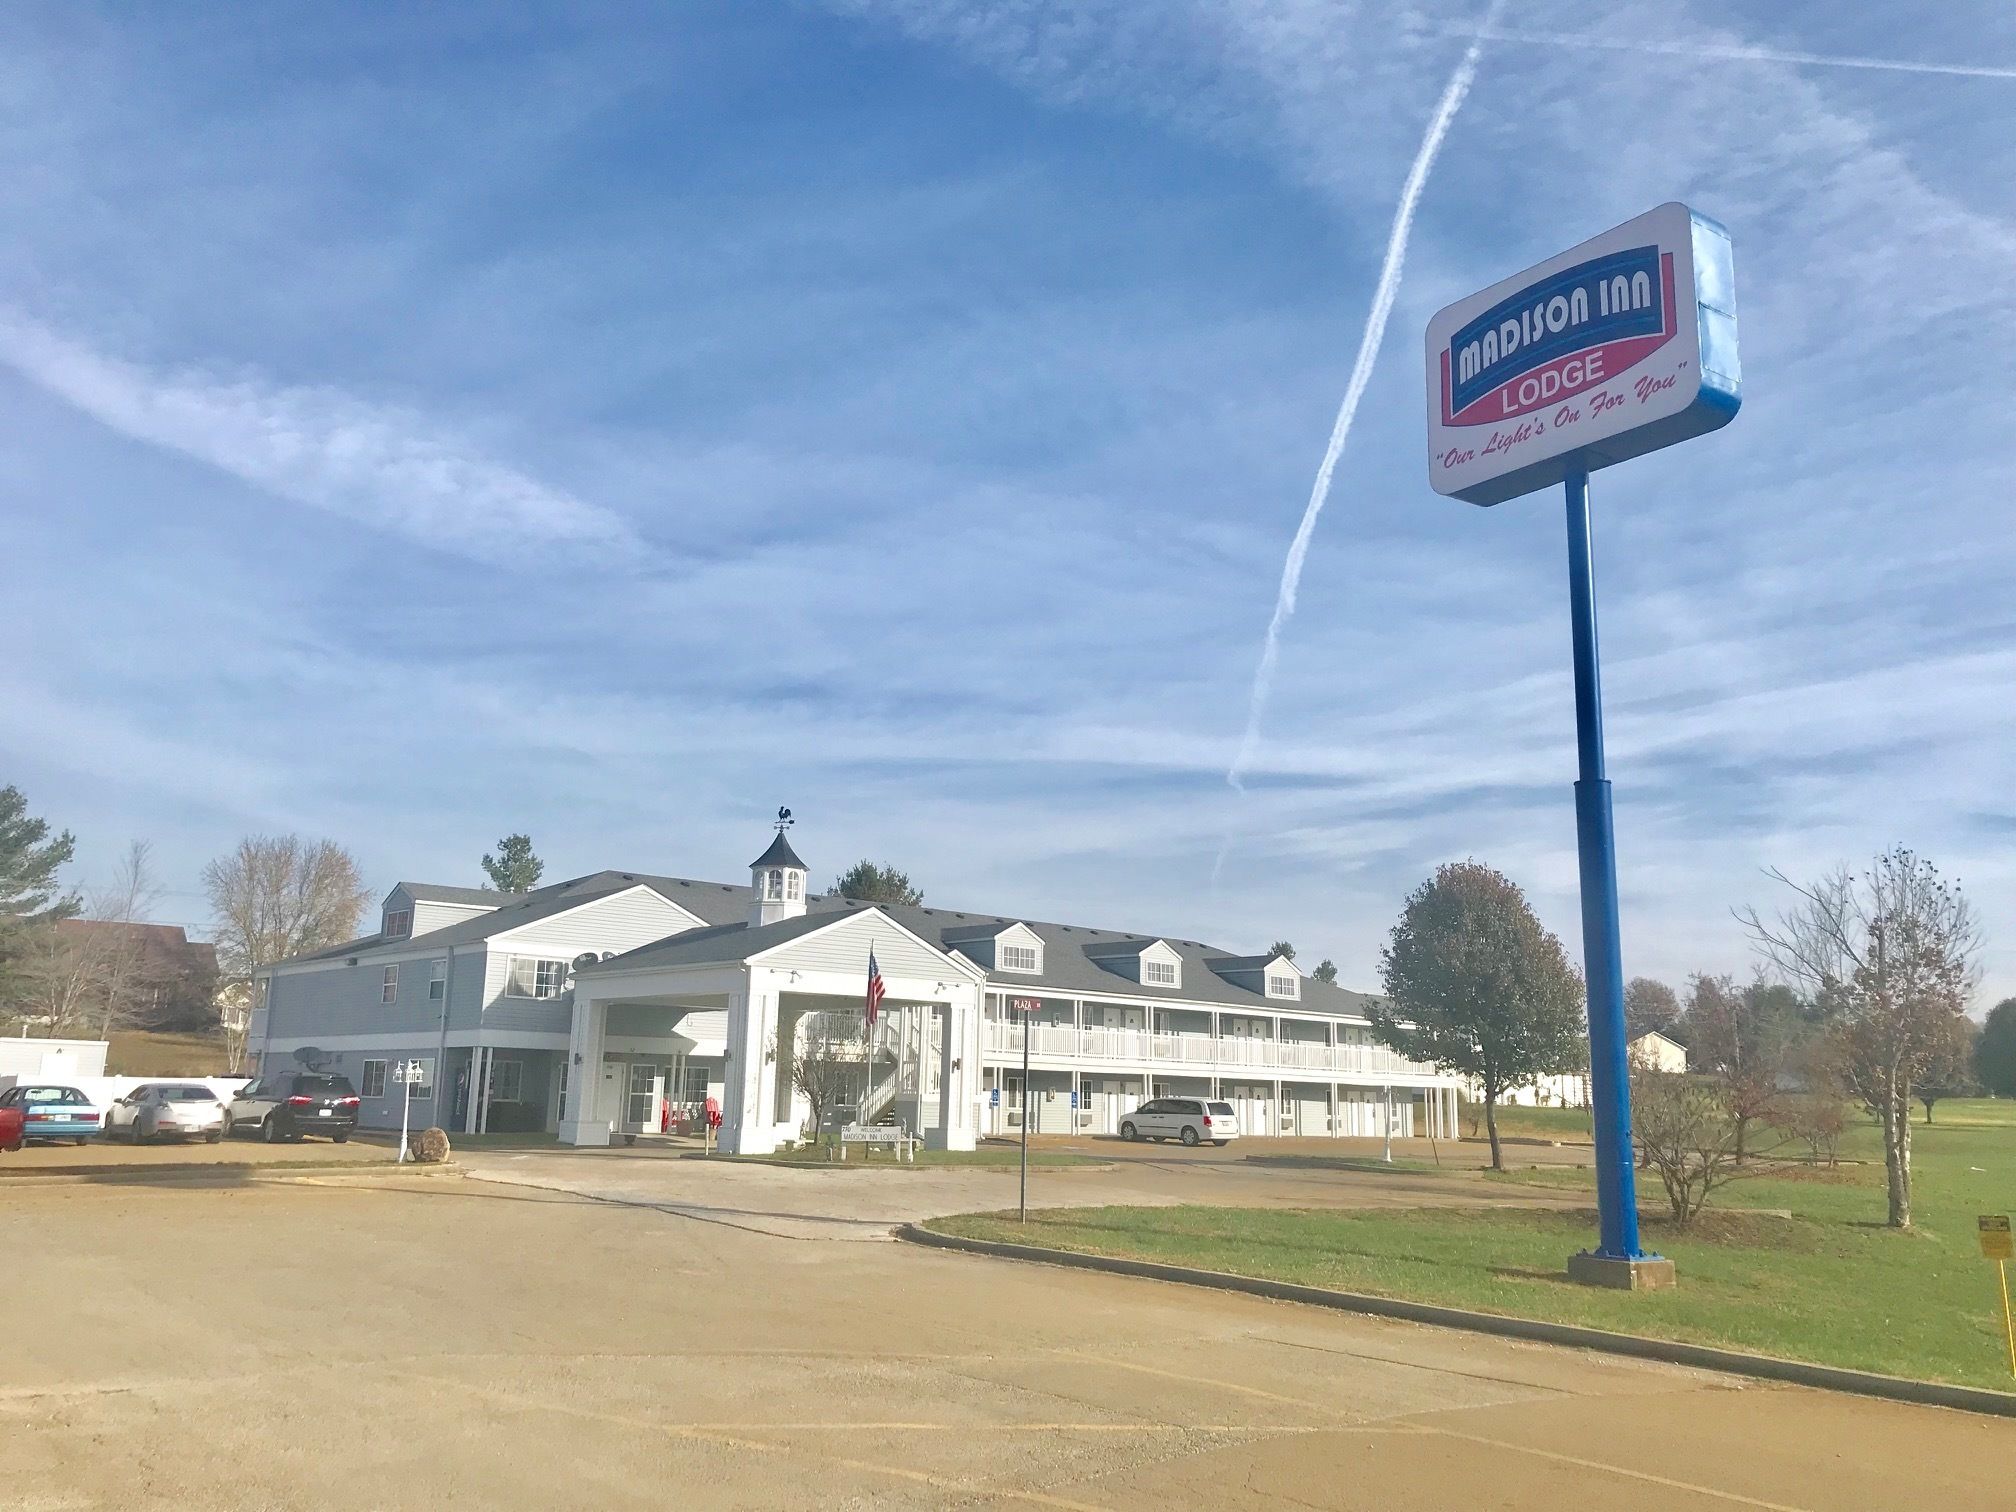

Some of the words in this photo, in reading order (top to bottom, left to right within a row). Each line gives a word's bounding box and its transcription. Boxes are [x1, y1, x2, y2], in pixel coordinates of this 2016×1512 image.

[1460, 286, 1589, 385] MADISON
[1600, 270, 1651, 317] INN
[1502, 351, 1605, 414] LODGE
[1481, 417, 1545, 455] Light's
[1554, 405, 1581, 428] On
[1589, 391, 1625, 419] For
[1014, 1000, 1032, 1009] PLAZA
